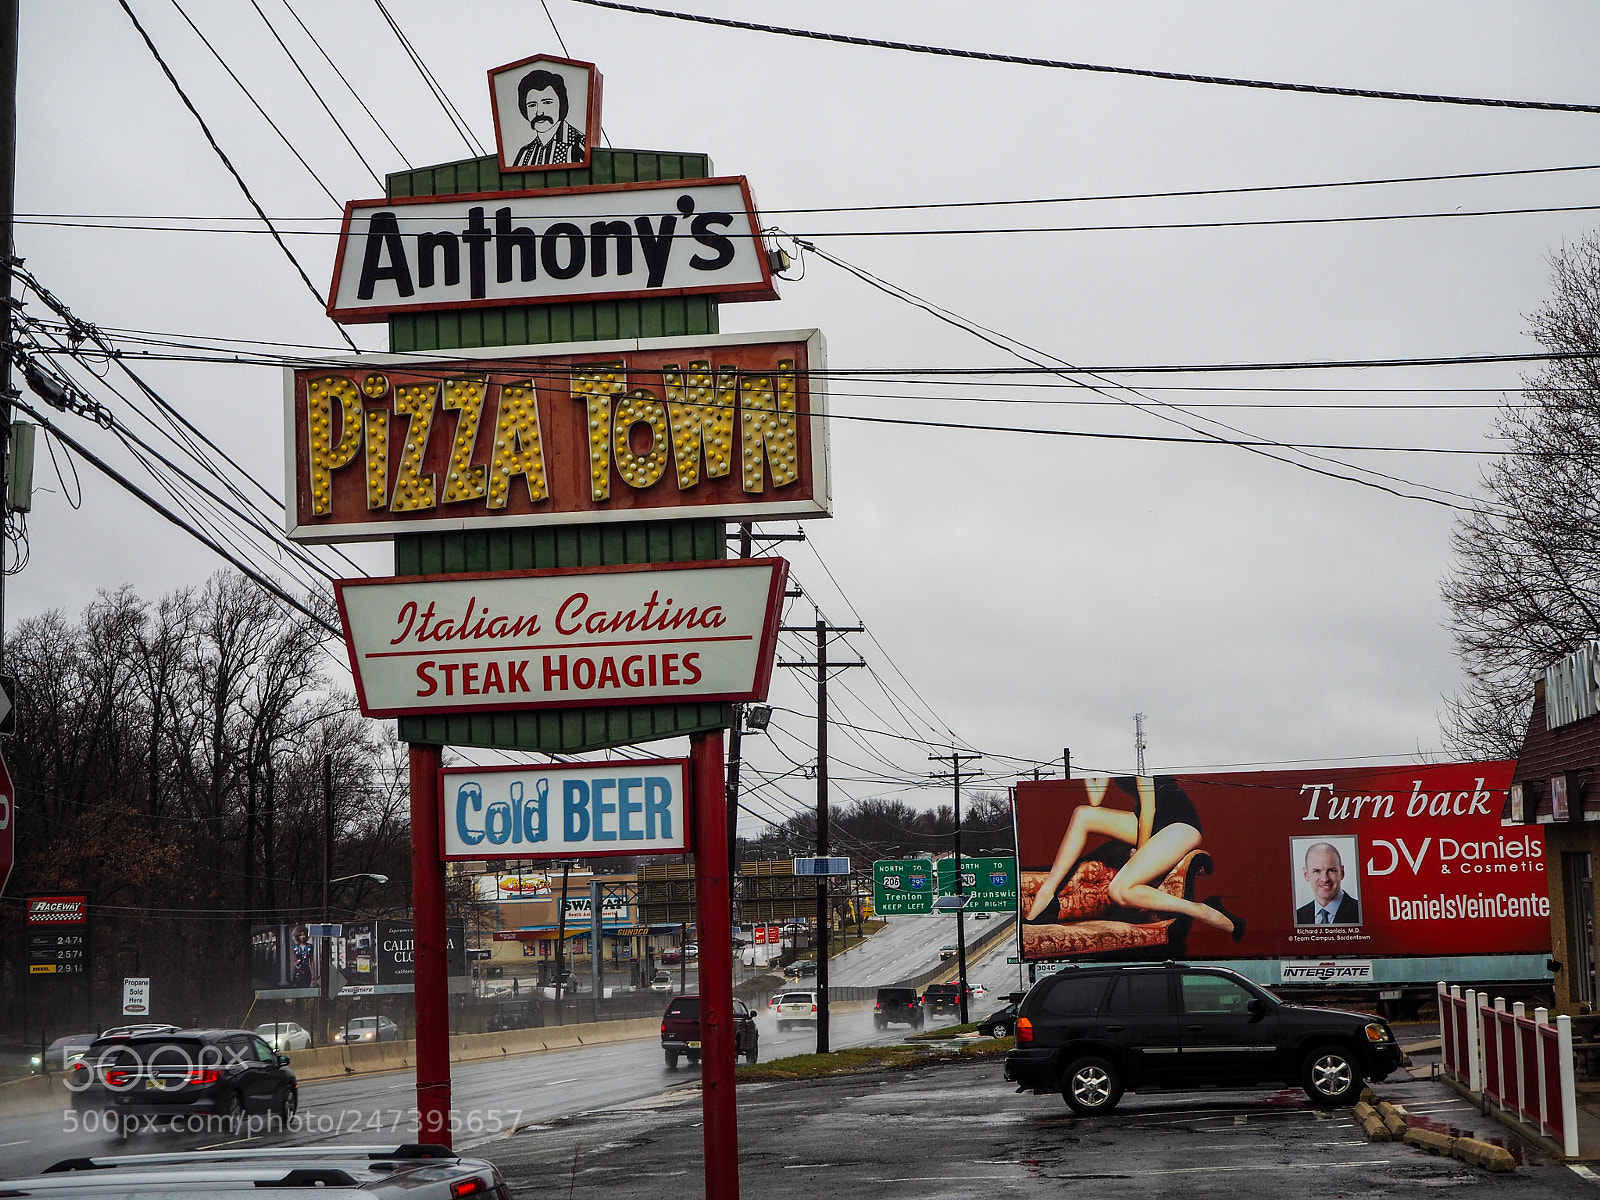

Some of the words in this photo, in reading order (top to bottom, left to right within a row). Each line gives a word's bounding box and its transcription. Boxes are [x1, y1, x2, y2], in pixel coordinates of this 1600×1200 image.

[357, 195, 735, 299] Anthony's
[390, 596, 541, 646] Italian
[555, 590, 727, 637] Cantina
[416, 659, 531, 698] STEAK
[543, 652, 703, 692] HOAGIES
[1299, 782, 1395, 821] Turn
[1407, 777, 1491, 818] back
[455, 777, 549, 845] Cold
[563, 776, 673, 842] BEER
[1439, 834, 1542, 861] Daniels
[1441, 863, 1451, 875] &
[1460, 860, 1545, 873] Cosmetic
[884, 877, 900, 886] 206
[993, 876, 1004, 884] 195
[885, 893, 922, 901] Trenton
[971, 890, 1016, 898] Brunswic
[31, 902, 82, 912] RACEWAY
[565, 900, 623, 912] SWAAT
[1389, 892, 1550, 921] DanielsVeinCente
[617, 928, 650, 936] SUNOCO
[383, 938, 455, 952] CALIA
[1283, 966, 1370, 977] INTERSTATE
[124, 978, 148, 986] Propane
